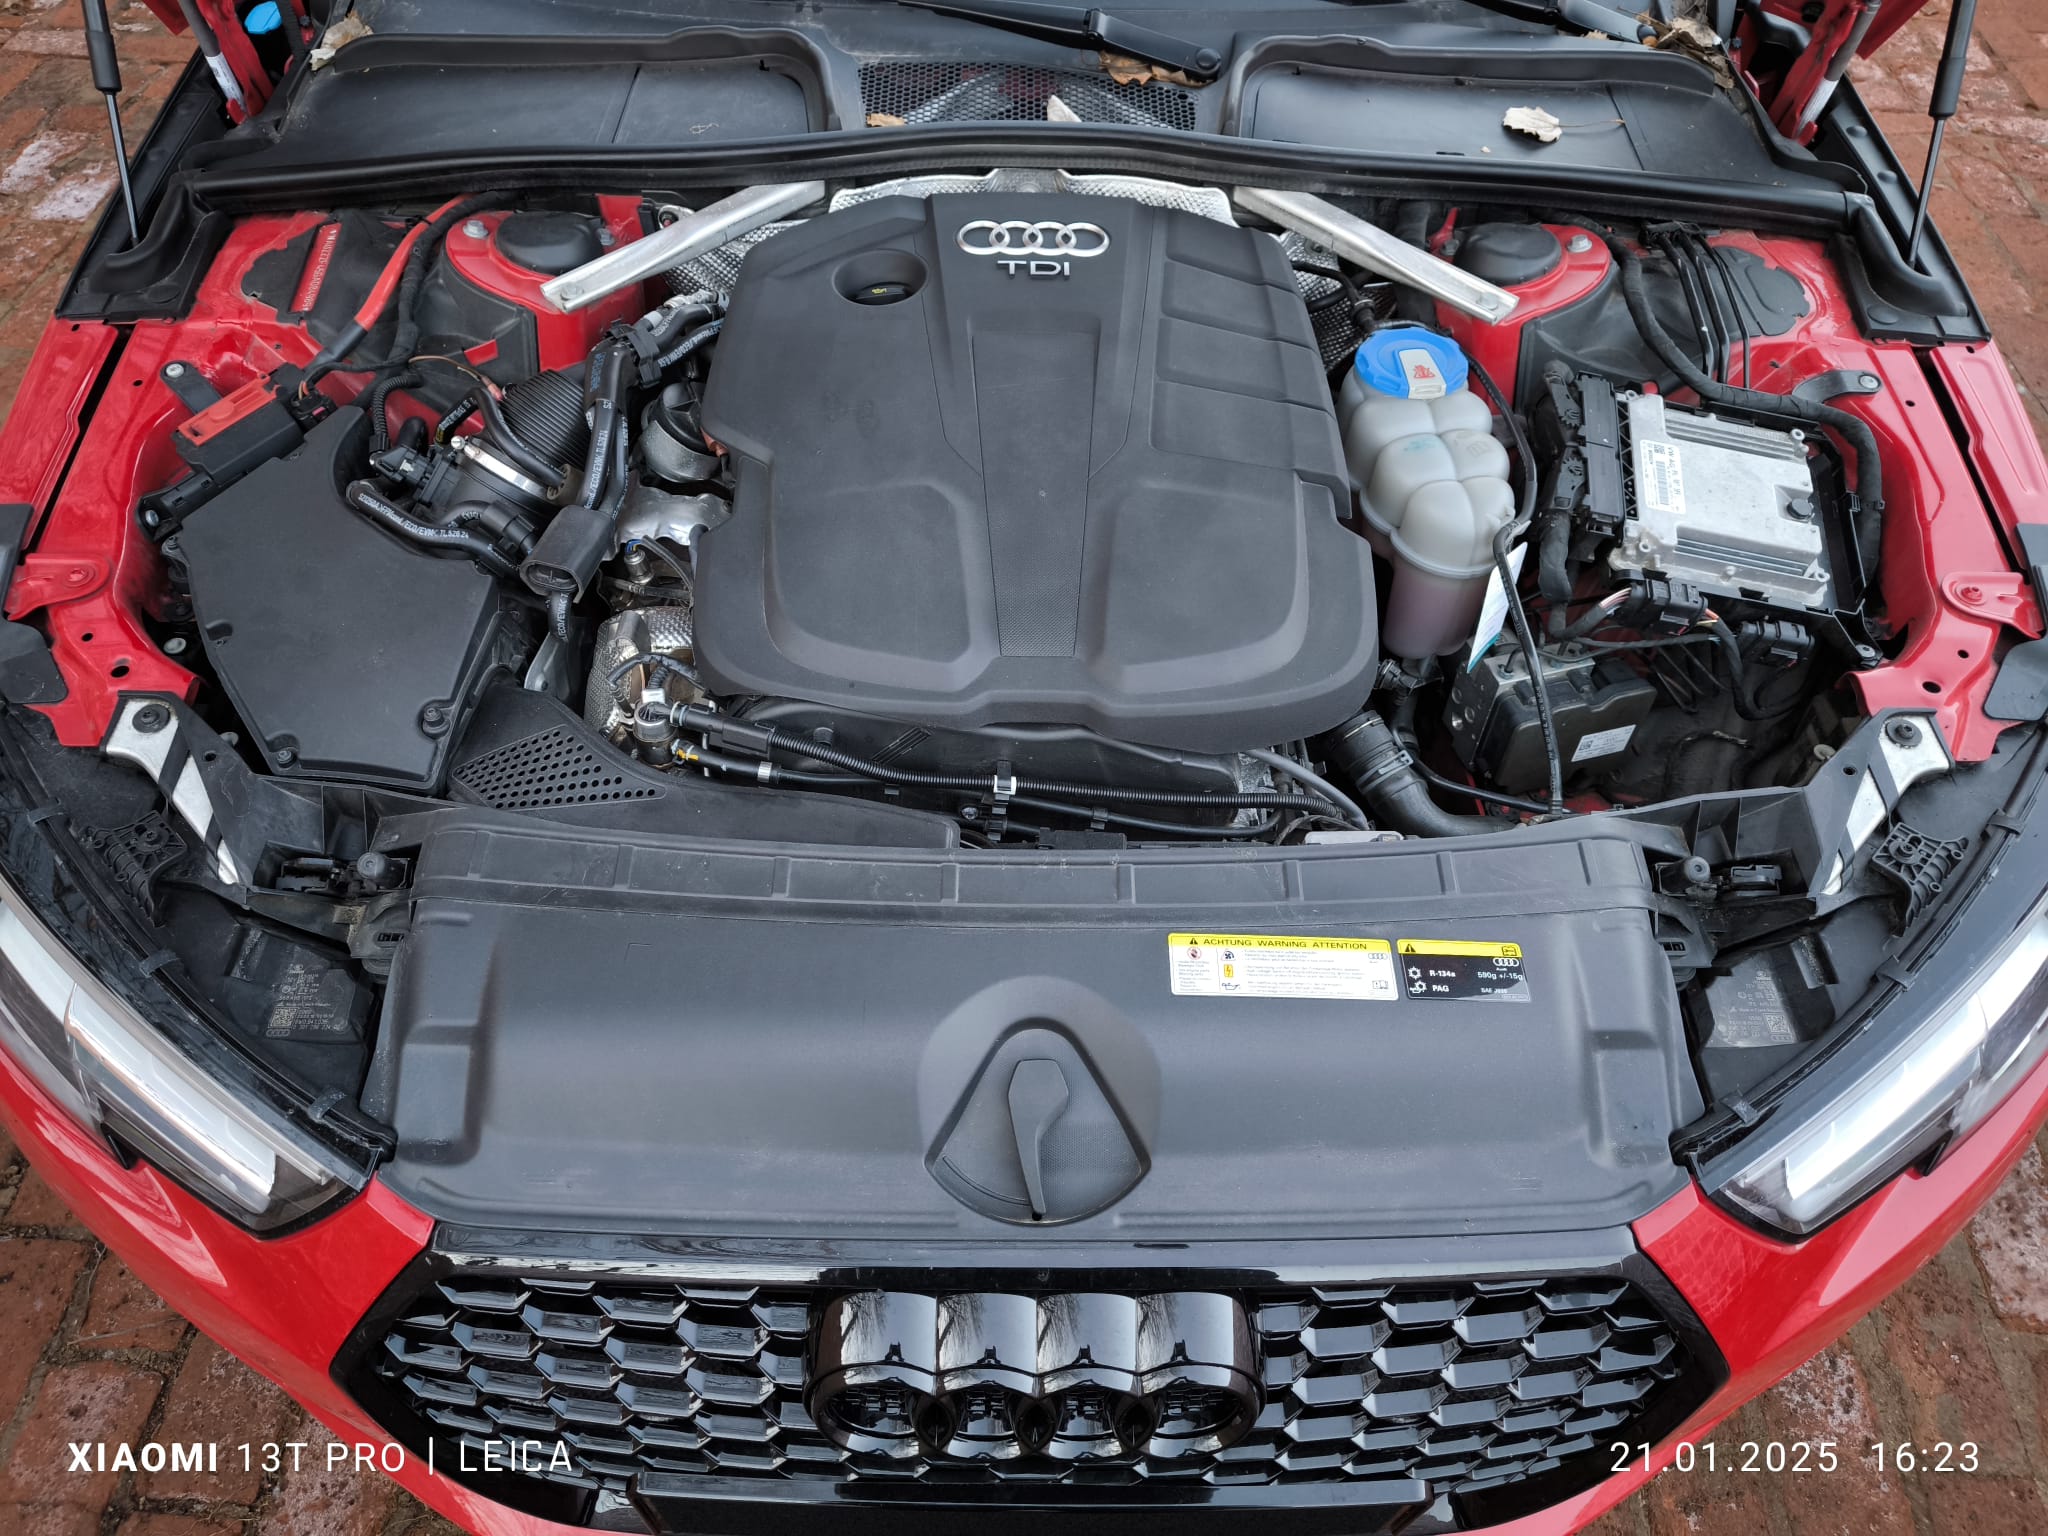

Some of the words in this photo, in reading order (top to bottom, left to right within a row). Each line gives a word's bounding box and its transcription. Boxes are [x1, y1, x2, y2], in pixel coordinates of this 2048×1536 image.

[997, 260, 1071, 276] TDI
[1203, 938, 1252, 946] ACHTUNG
[1257, 939, 1307, 948] WARNING
[1312, 941, 1367, 950] ATTENTION
[1429, 969, 1456, 978] R-134a
[1432, 984, 1449, 992] PAG
